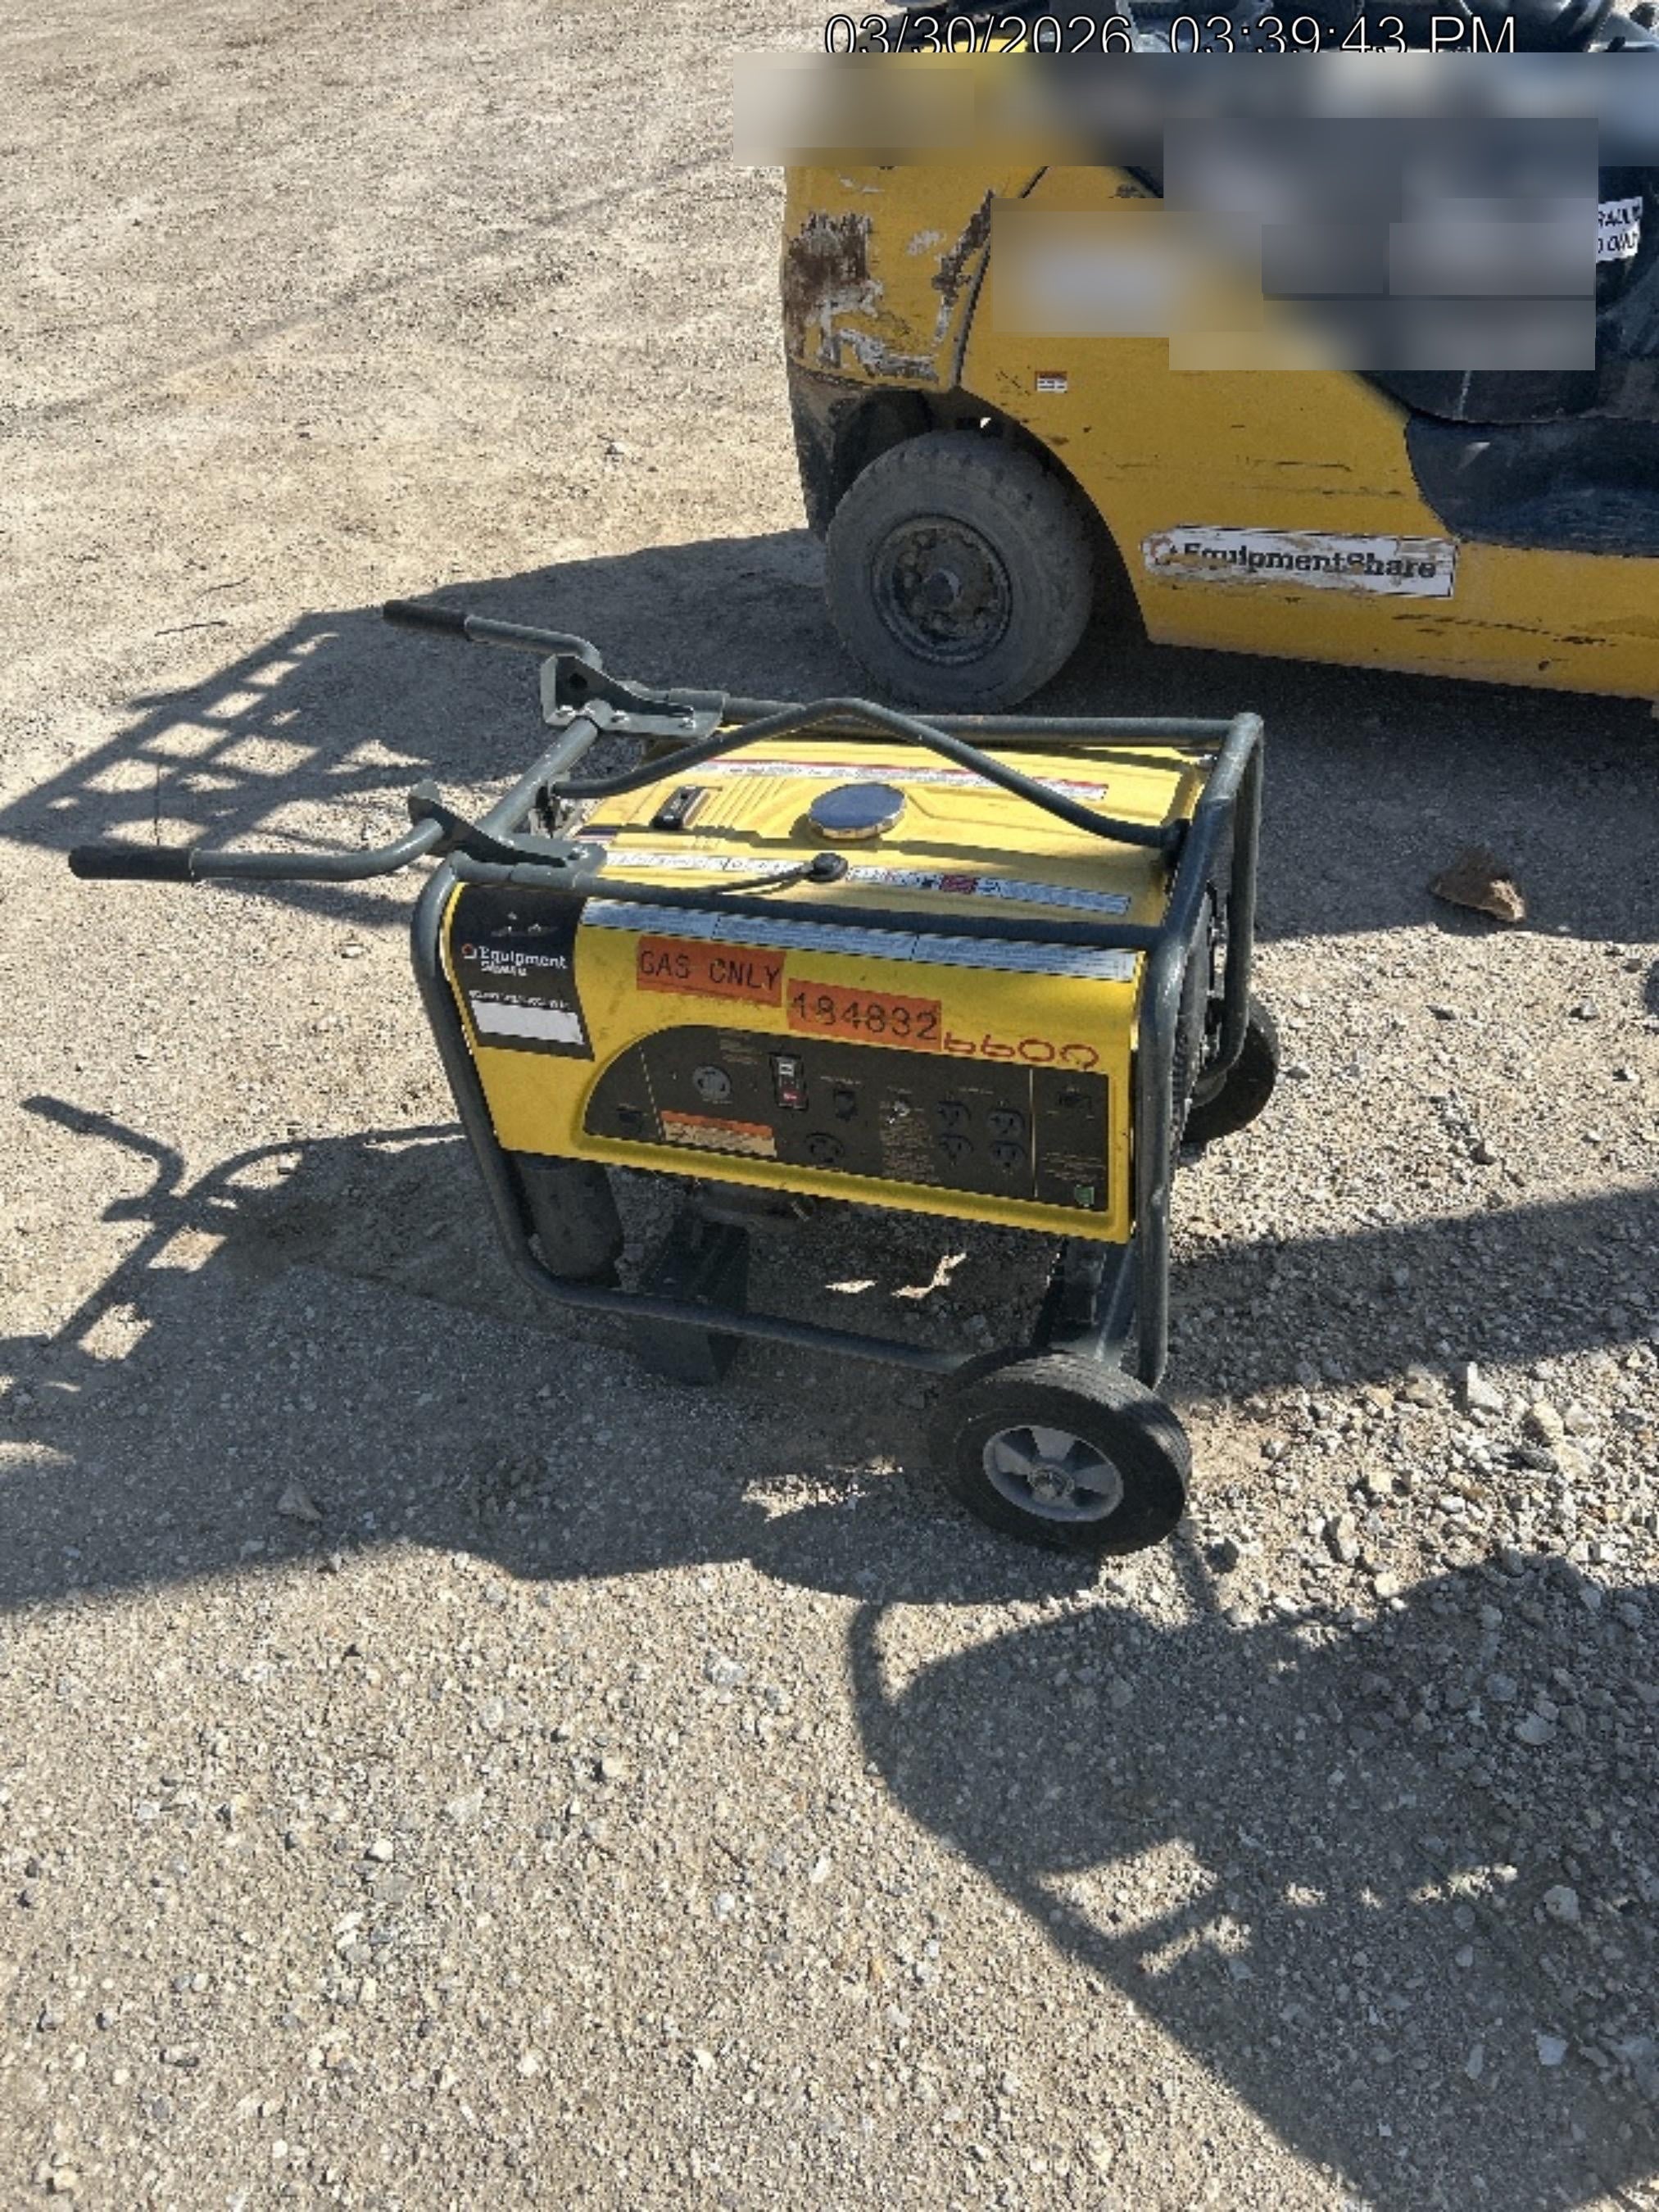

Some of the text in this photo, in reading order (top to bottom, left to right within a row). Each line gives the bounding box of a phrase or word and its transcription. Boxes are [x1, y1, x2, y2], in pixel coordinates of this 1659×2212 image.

[641, 950, 780, 990] GAS ONLY
[793, 991, 938, 1040] 184832
